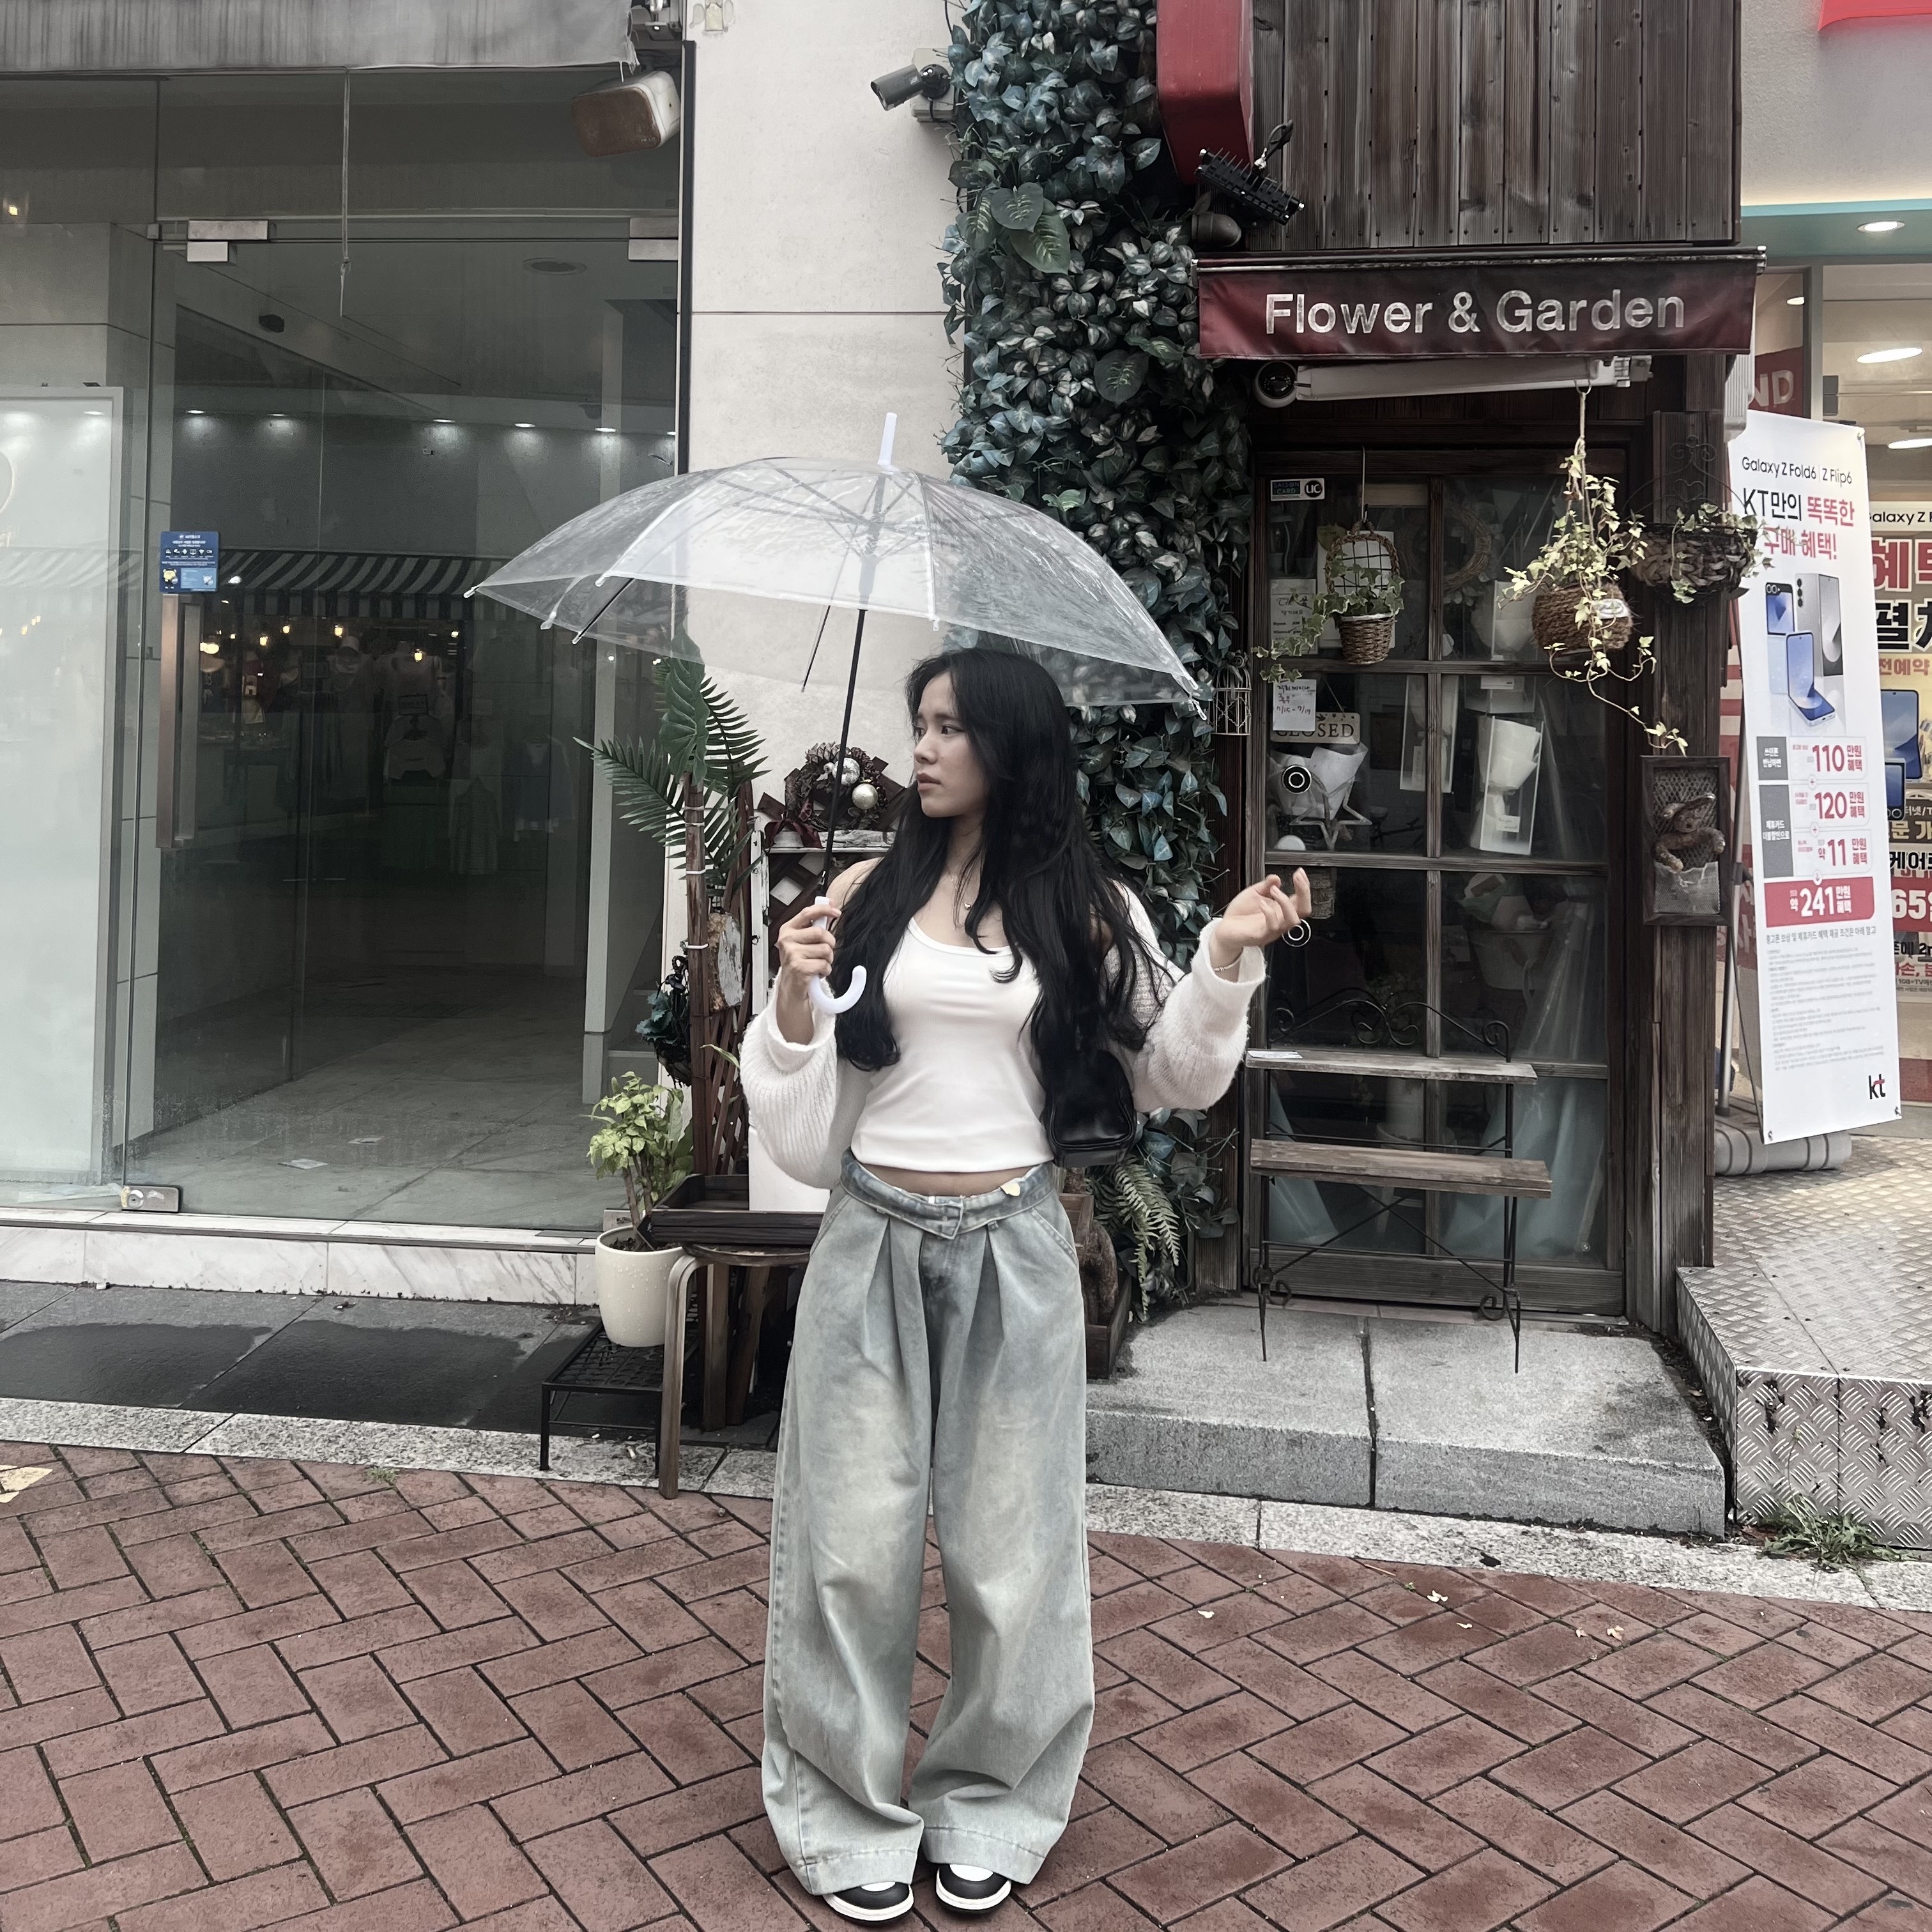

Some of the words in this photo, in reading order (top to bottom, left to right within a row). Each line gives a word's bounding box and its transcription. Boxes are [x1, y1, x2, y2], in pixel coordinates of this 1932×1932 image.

[1266, 292, 1432, 335] Flower
[1448, 290, 1481, 334] &
[1496, 289, 1685, 333] Garden
[1742, 456, 1779, 478] Galaxy
[1781, 462, 1788, 475] Z
[1790, 463, 1816, 479] Fold6
[1822, 468, 1828, 481] Z
[1830, 468, 1852, 487] Flip6
[1744, 487, 1802, 521] KT만의
[1807, 496, 1855, 526] 똑똑한
[1869, 511, 1915, 525] alaxy
[1917, 512, 1926, 522] Z
[1801, 530, 1837, 560] 혜택!
[1812, 745, 1844, 772] 110
[1847, 745, 1862, 757] 만원
[1814, 792, 1847, 819] 120
[1850, 792, 1864, 804] 만원
[1827, 839, 1846, 866] 11
[1852, 838, 1867, 850] 만원
[1889, 851, 1932, 870] 케어
[1800, 886, 1834, 917] 241
[1891, 889, 1932, 919] 65
[1868, 1073, 1886, 1100] kt
